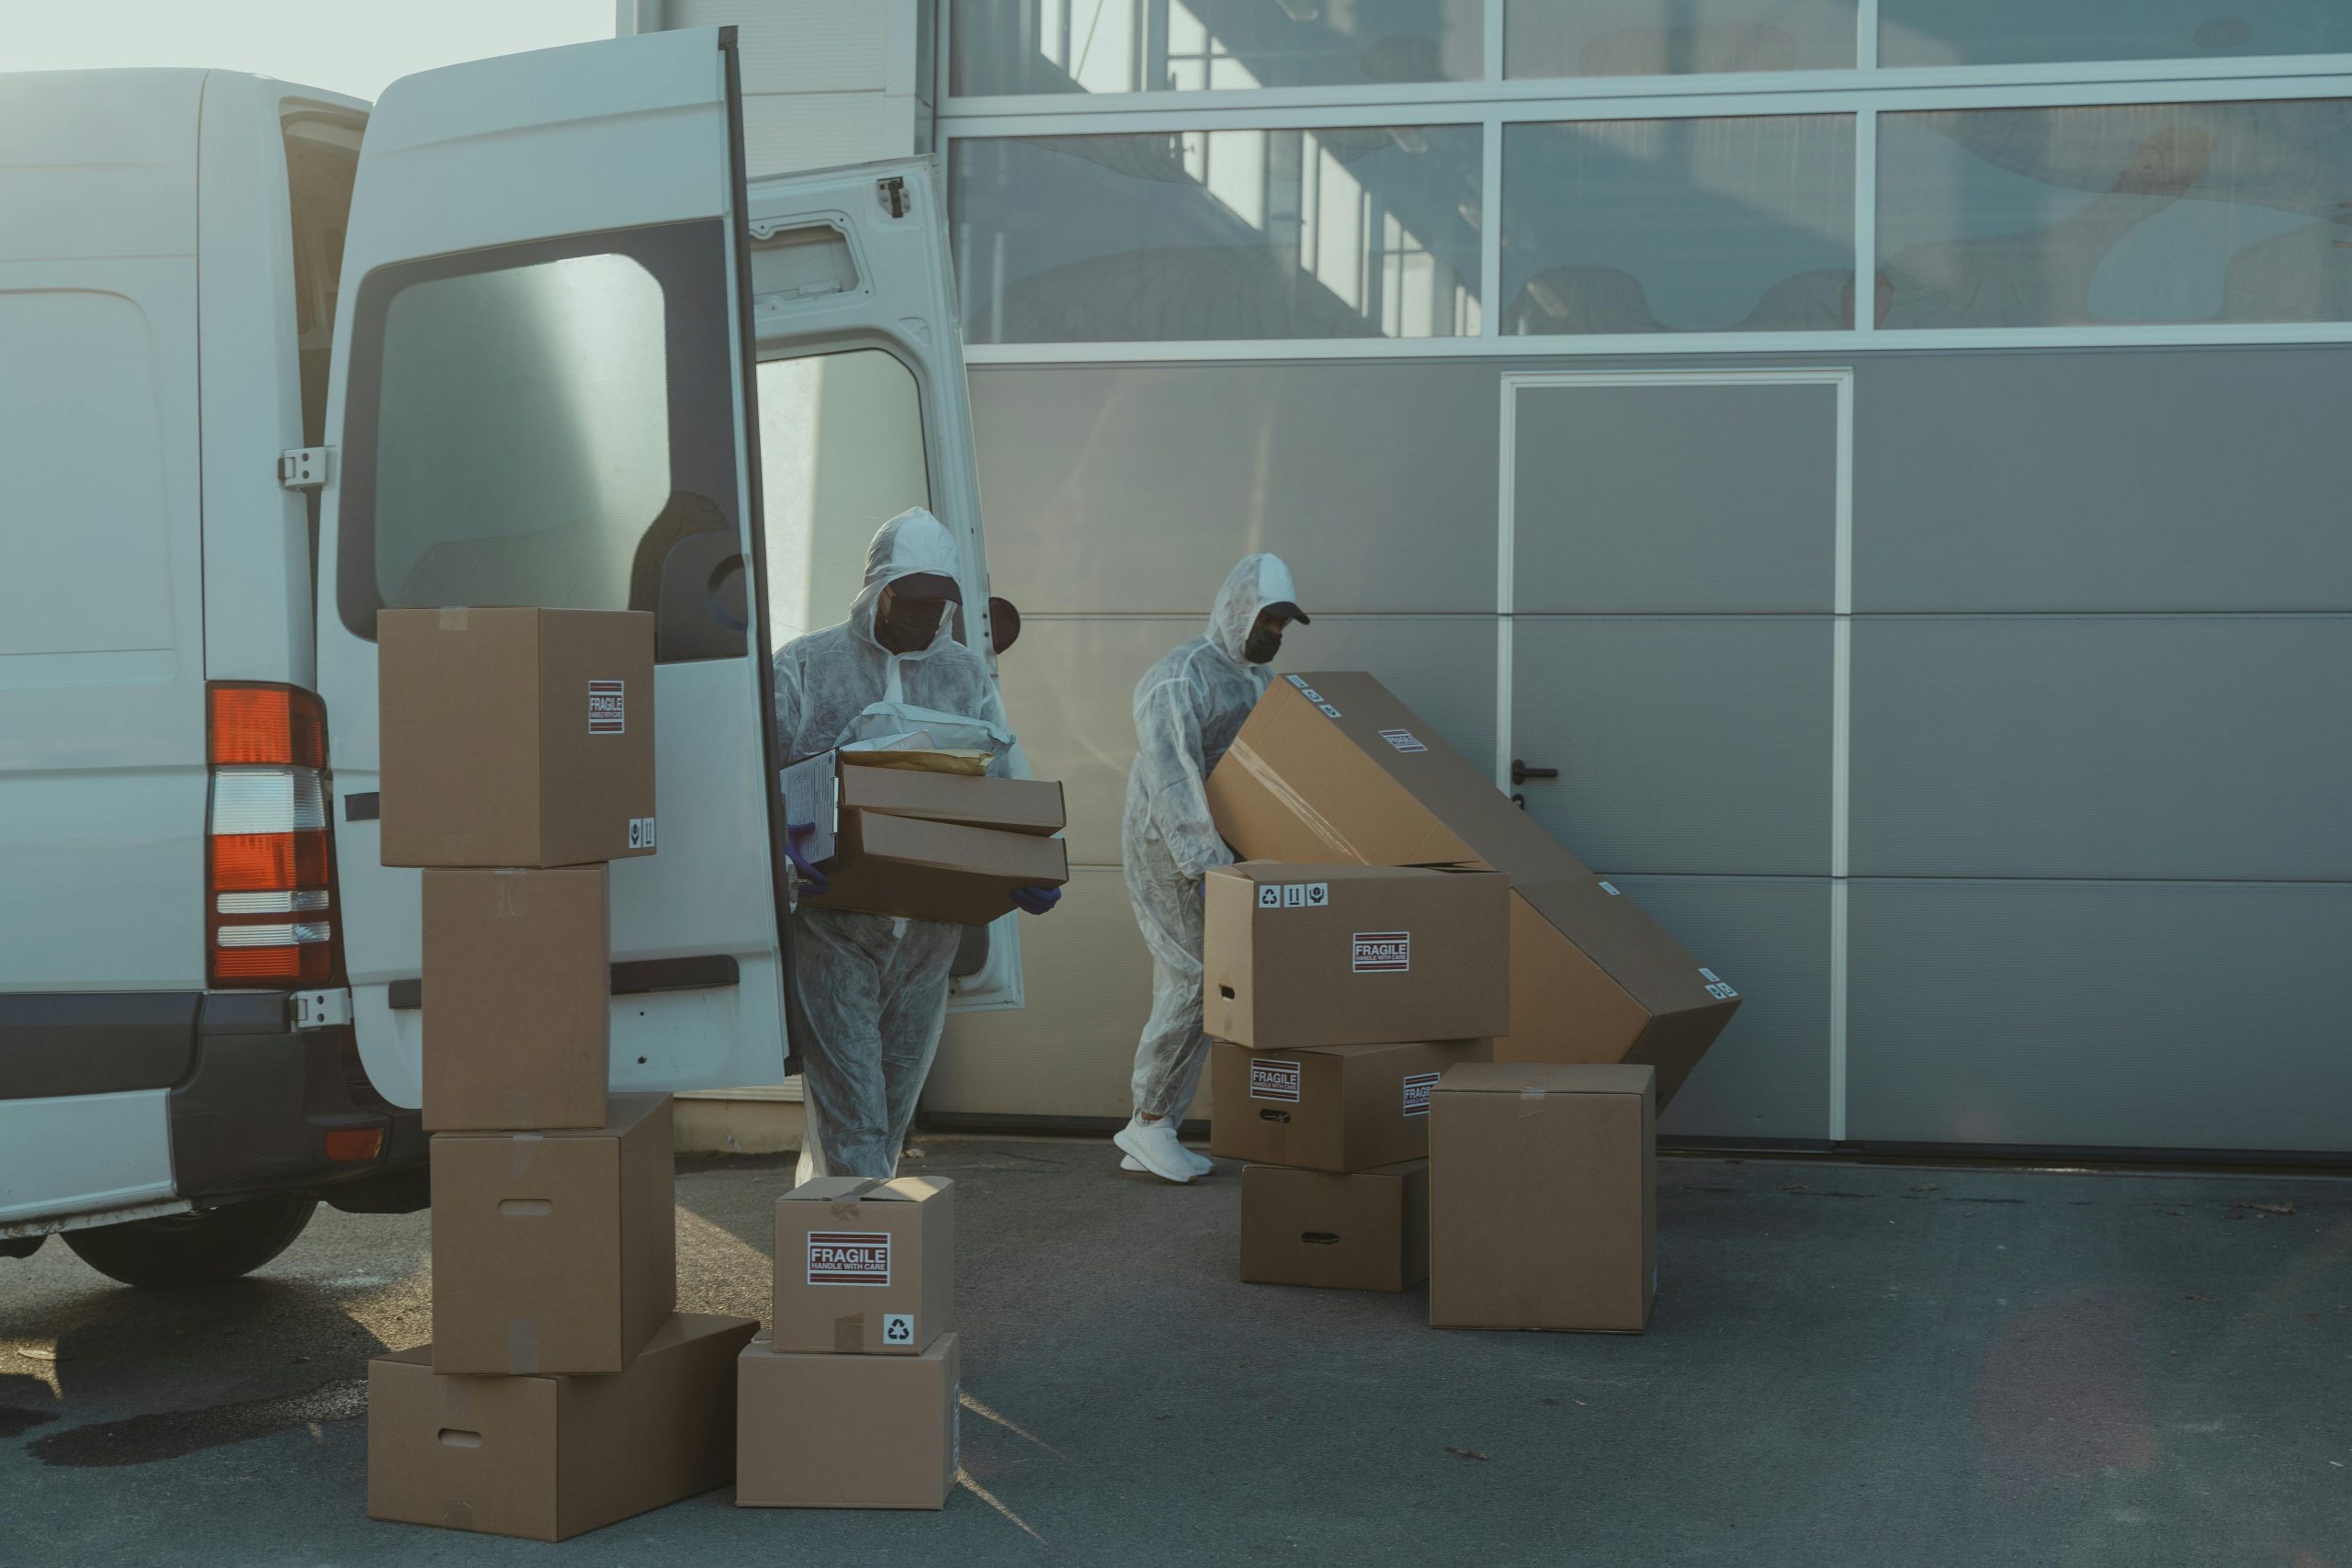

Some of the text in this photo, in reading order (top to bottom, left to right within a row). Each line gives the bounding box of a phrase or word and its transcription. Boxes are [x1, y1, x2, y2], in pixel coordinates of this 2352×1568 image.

[591, 697, 622, 711] FRAGILE
[1355, 944, 1407, 955] FRAGILE
[1253, 1071, 1296, 1086] FRAGILE
[1406, 1086, 1430, 1100] FRAGI
[810, 1248, 886, 1264] FRAGILE
